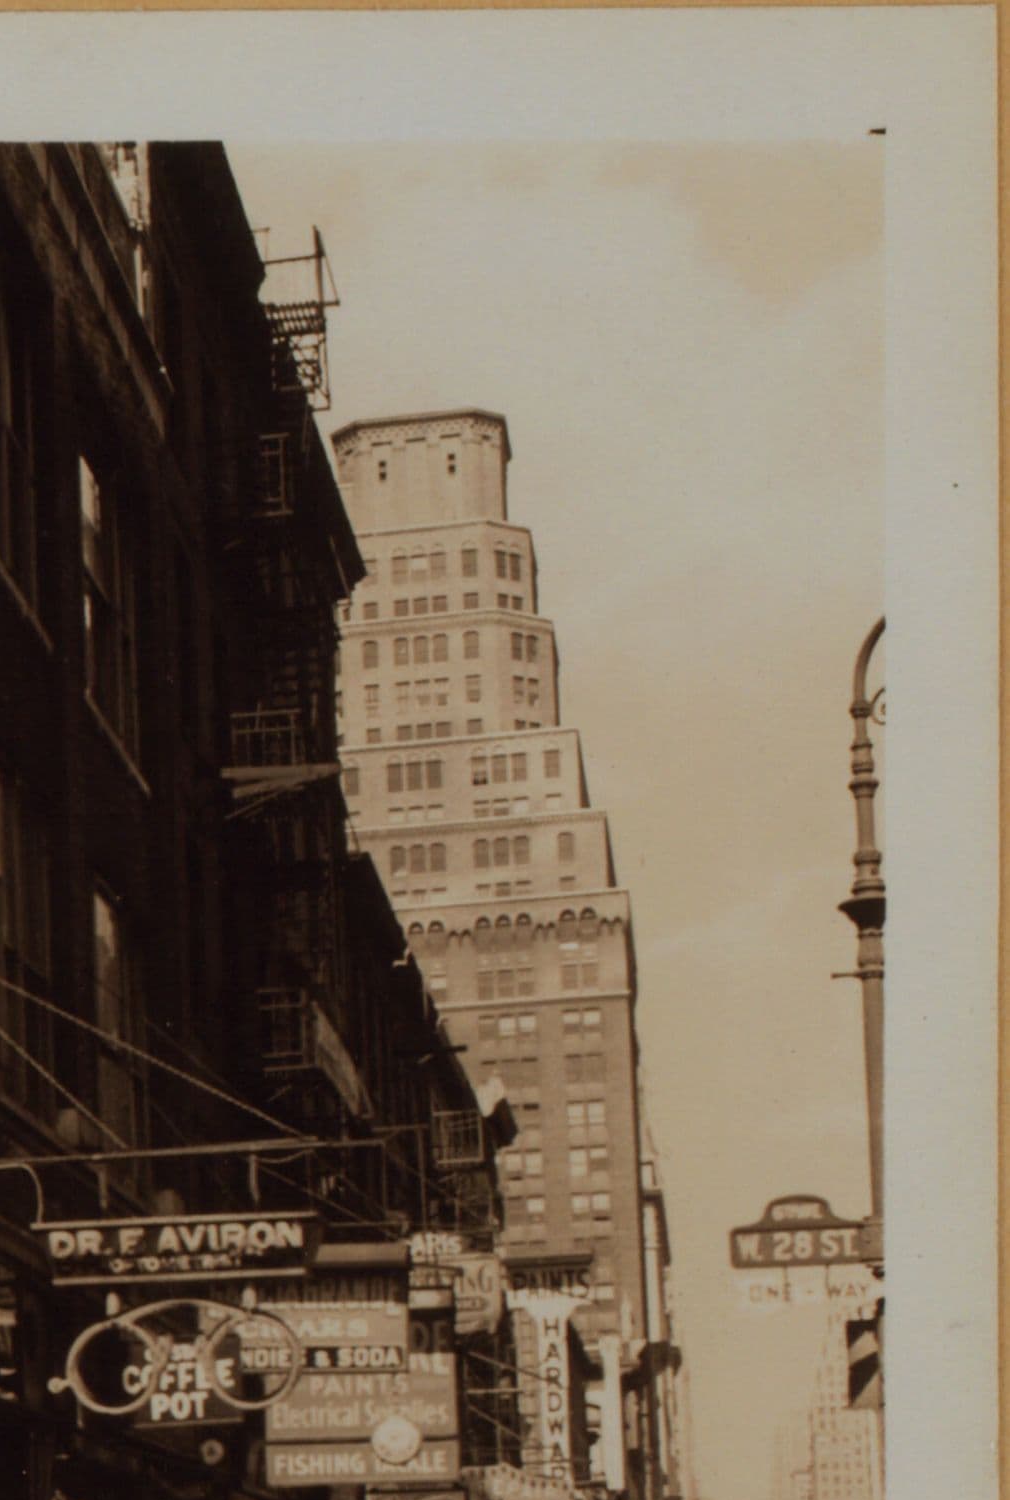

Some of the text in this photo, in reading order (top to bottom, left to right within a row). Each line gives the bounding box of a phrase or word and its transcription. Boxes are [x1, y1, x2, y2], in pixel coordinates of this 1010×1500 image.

[48, 1229, 114, 1259] DR.
[157, 1220, 303, 1254] AVIRON
[773, 1230, 813, 1260] 28
[511, 1268, 589, 1297] PAINTS
[826, 1282, 869, 1301] WAY
[240, 1347, 308, 1368] NDIE
[336, 1346, 402, 1368] SODA
[309, 1374, 409, 1397] PAINTS
[542, 1317, 569, 1480] HARDWAR
[150, 1390, 209, 1422] POT
[271, 1399, 360, 1430] Electrical
[273, 1451, 366, 1476] FISHING
